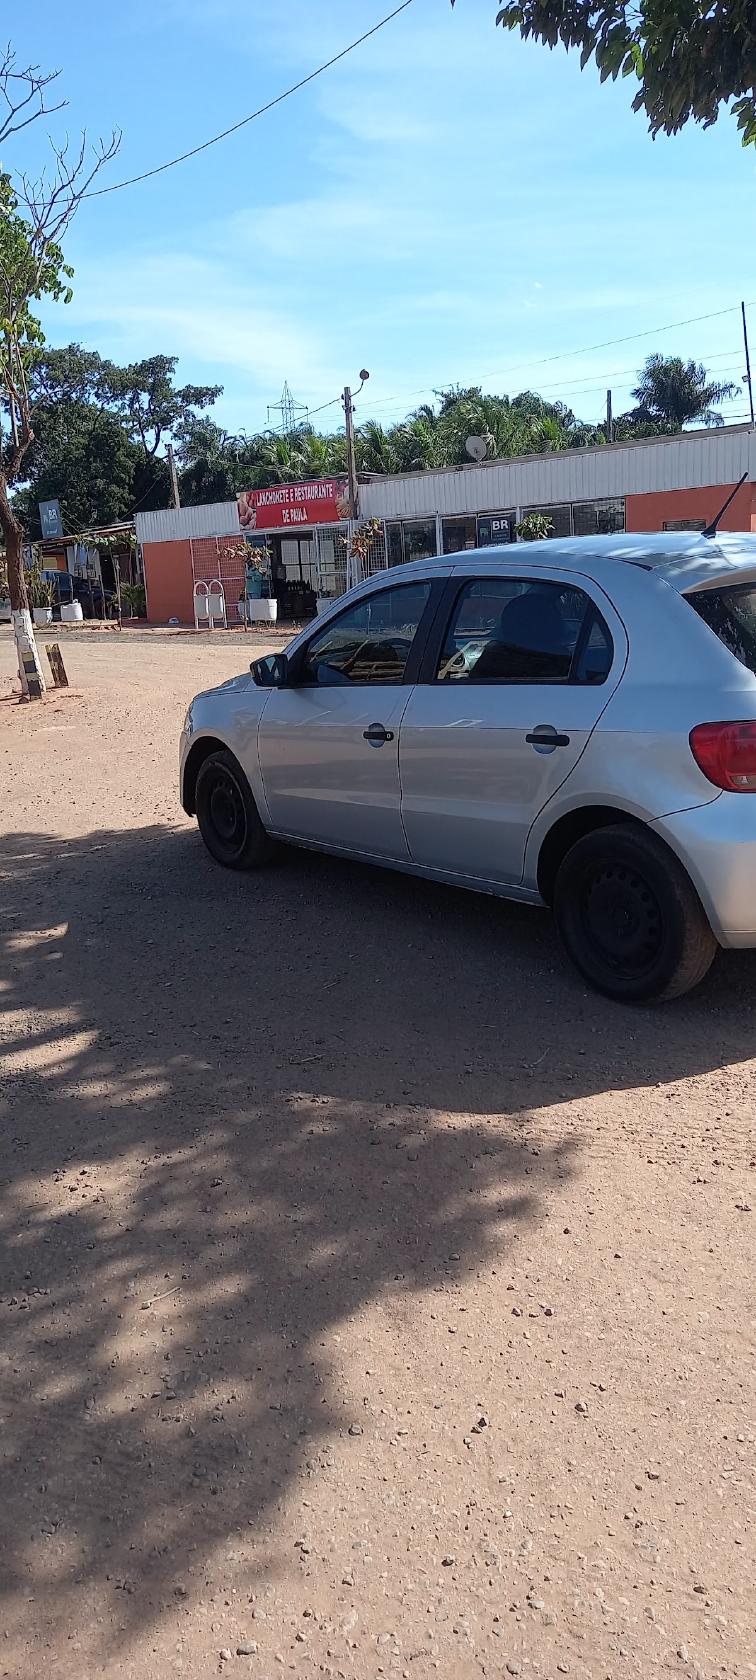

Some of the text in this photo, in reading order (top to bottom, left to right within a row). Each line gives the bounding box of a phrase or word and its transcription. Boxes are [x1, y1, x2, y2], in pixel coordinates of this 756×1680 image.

[256, 484, 333, 506] LANCHONETE E RESTAURANTE
[282, 507, 308, 523] DE PAULA
[493, 520, 508, 530] BR
